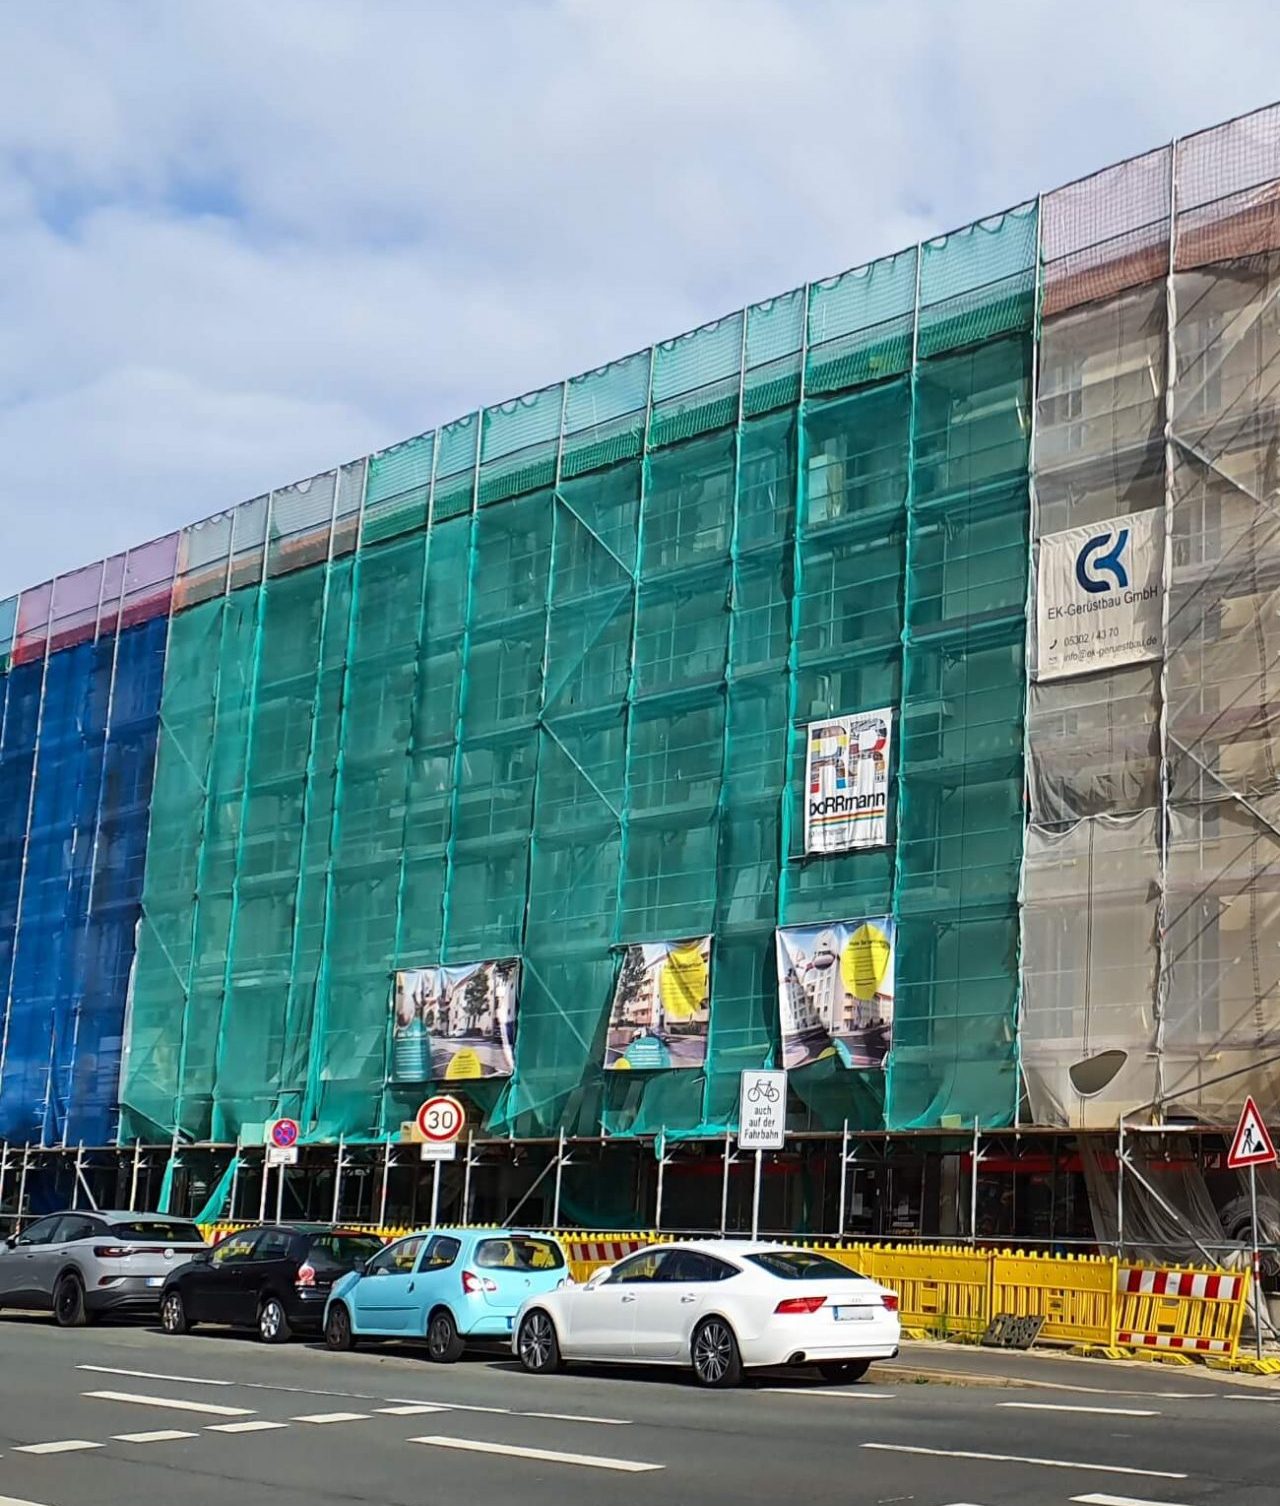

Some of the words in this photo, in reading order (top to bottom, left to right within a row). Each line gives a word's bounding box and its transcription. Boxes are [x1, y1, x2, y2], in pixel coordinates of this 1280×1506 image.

[1048, 596, 1121, 620] EK-Gerüstbau
[1124, 585, 1158, 604] GmbH
[1064, 633, 1089, 648] 05302
[809, 792, 885, 816] boRRmann
[754, 1105, 772, 1115] auch
[428, 1110, 453, 1129] 30
[749, 1117, 761, 1128] auf
[763, 1117, 776, 1128] der
[744, 1128, 779, 1140] Fahrbahn
